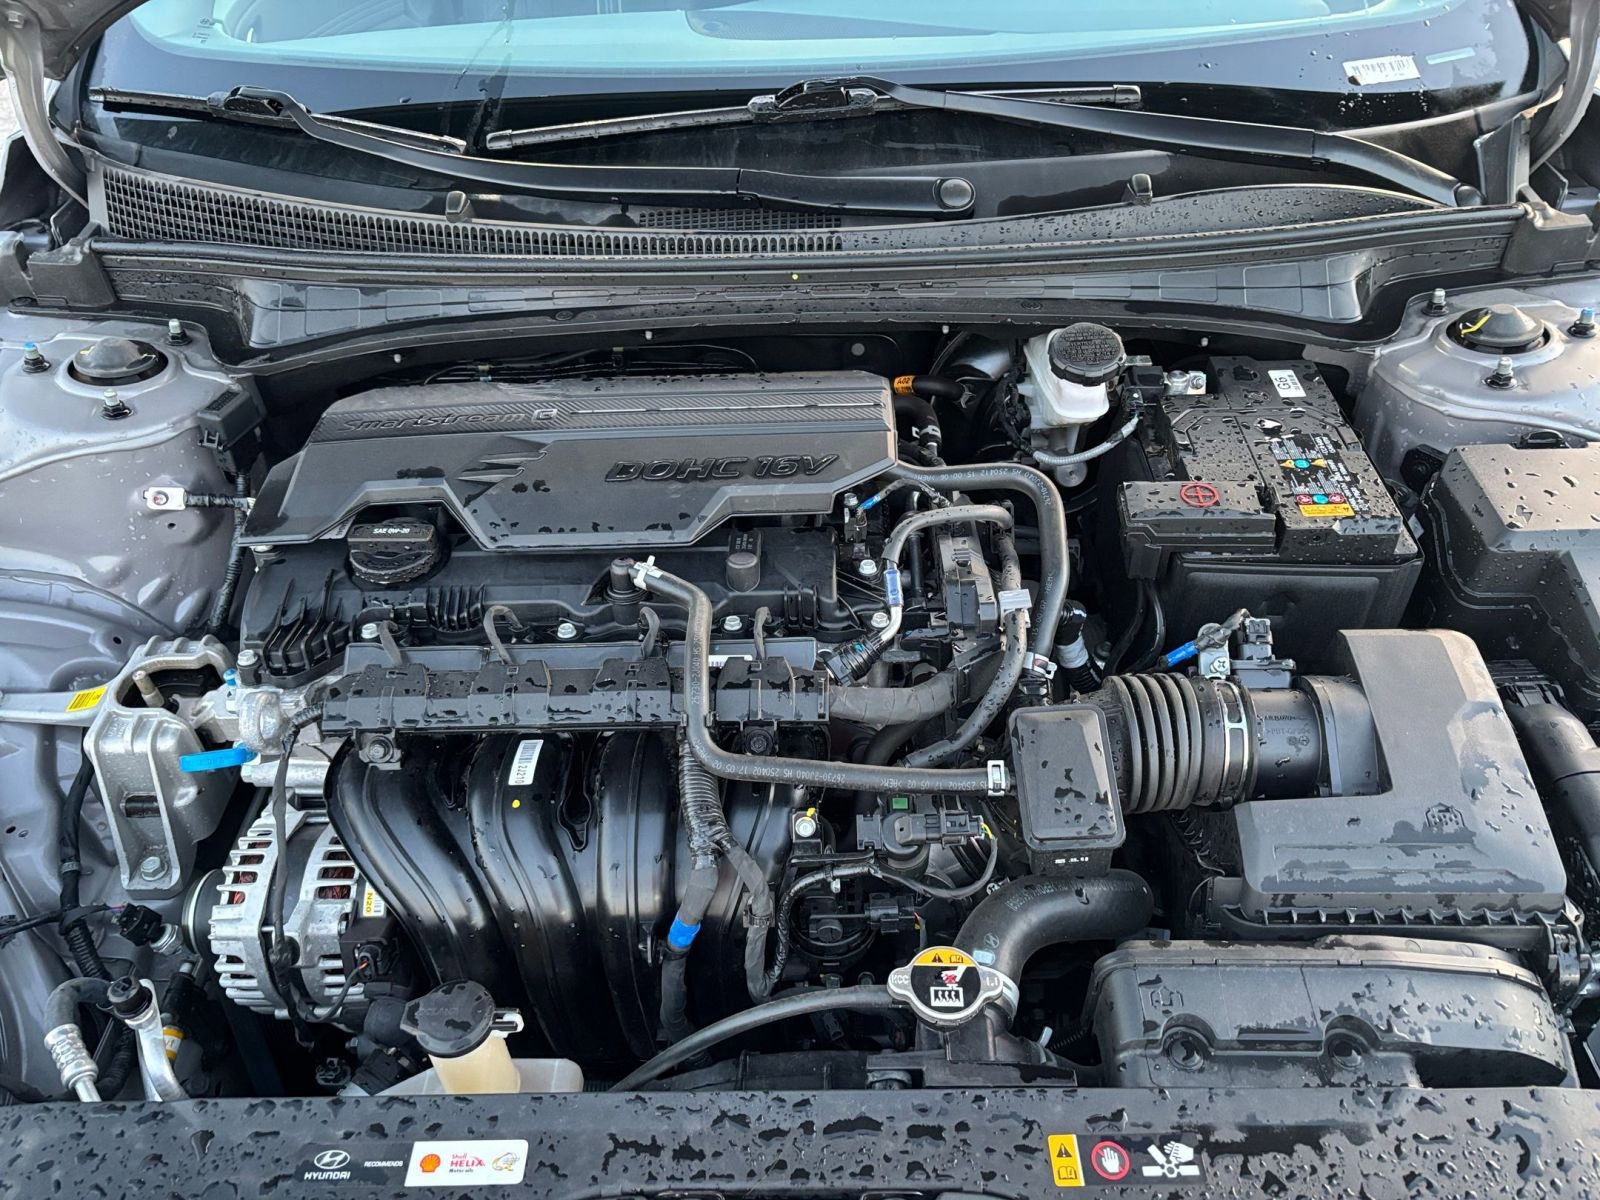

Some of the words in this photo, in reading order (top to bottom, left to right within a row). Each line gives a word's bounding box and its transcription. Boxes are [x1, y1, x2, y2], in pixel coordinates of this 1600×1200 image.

[1275, 377, 1292, 391] G6
[338, 412, 526, 432] Smartstream
[604, 456, 748, 483] DOHC
[754, 453, 840, 479] 16V
[372, 527, 387, 535] SAE
[387, 527, 411, 535] 0W-20
[365, 891, 374, 914] N20
[363, 1160, 404, 1168] RECOMMENDS
[449, 1159, 483, 1167] HELIX
[303, 1170, 352, 1181] HYUNDAI
